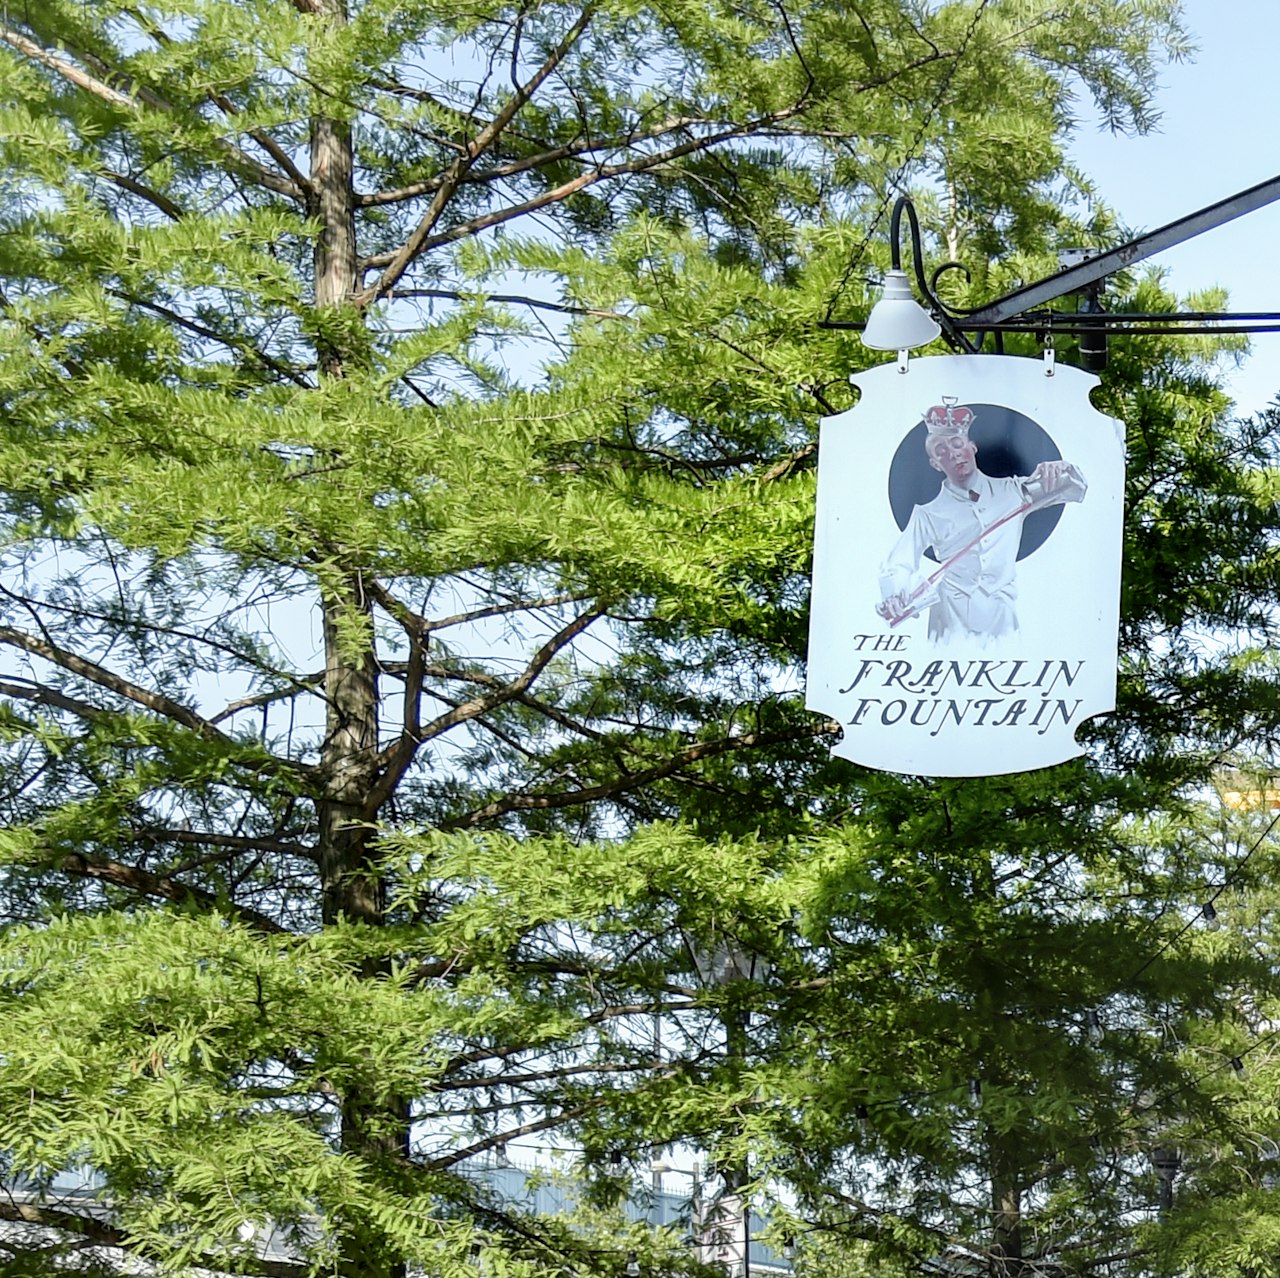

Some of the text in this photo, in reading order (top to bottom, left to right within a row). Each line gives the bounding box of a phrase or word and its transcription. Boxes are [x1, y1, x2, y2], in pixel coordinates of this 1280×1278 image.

[853, 634, 910, 651] THE
[839, 659, 1085, 697] FRANKLIN
[847, 698, 1084, 737] FOUNTAIN
